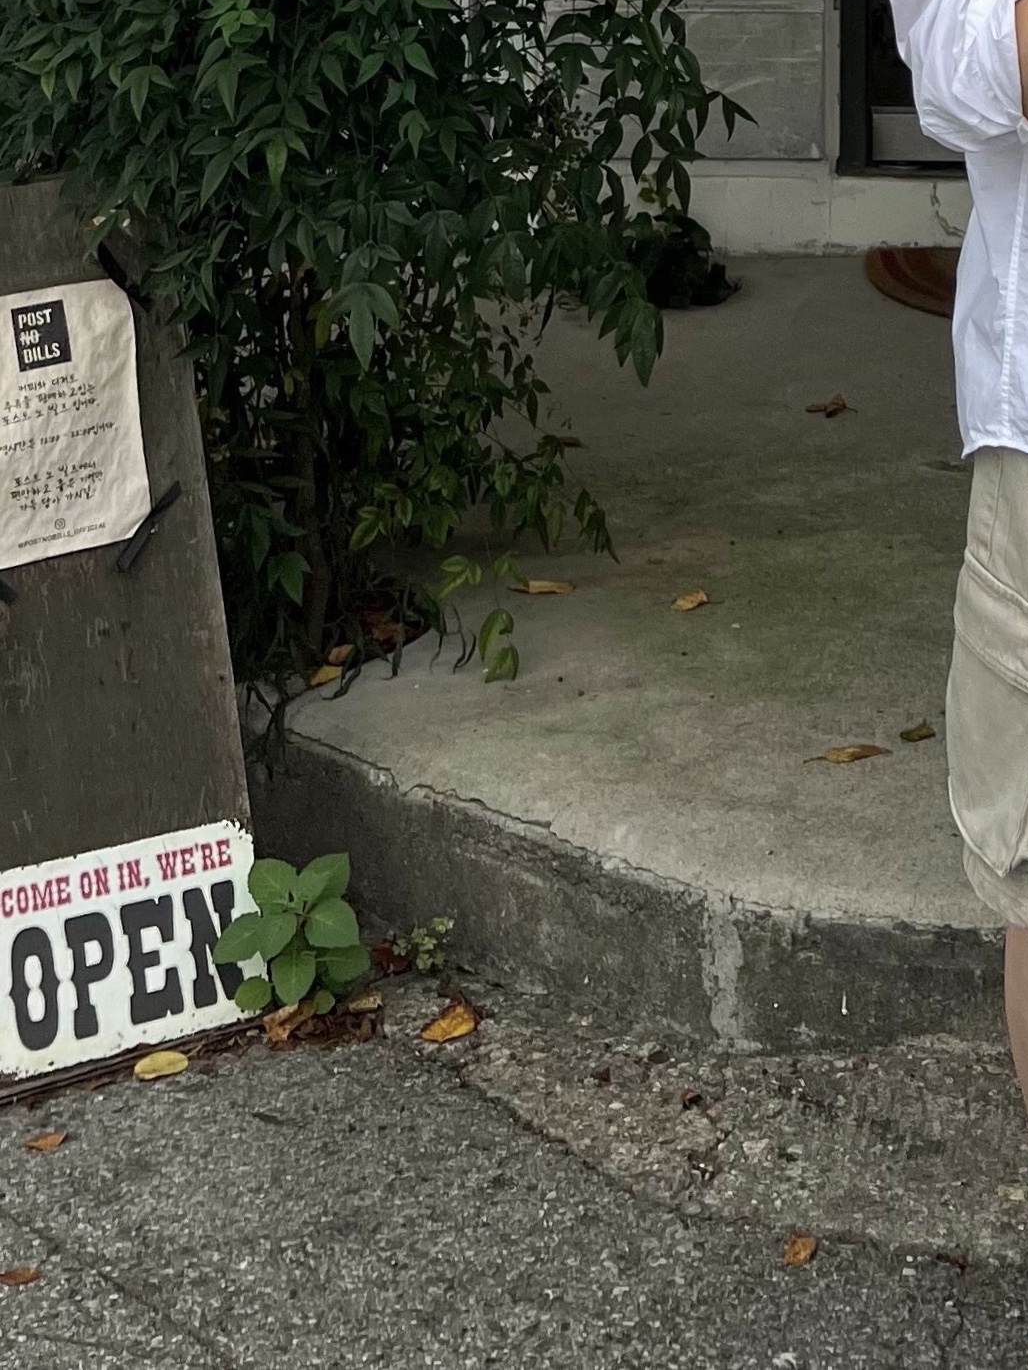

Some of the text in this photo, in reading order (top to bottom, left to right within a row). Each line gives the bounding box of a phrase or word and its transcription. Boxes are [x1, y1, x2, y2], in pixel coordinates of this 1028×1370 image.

[18, 308, 52, 329] POST
[20, 329, 41, 346] NO
[23, 342, 60, 364] BILLS
[1, 838, 233, 919] COME ON IN, WE'RE
[9, 879, 245, 1052] OPEN
